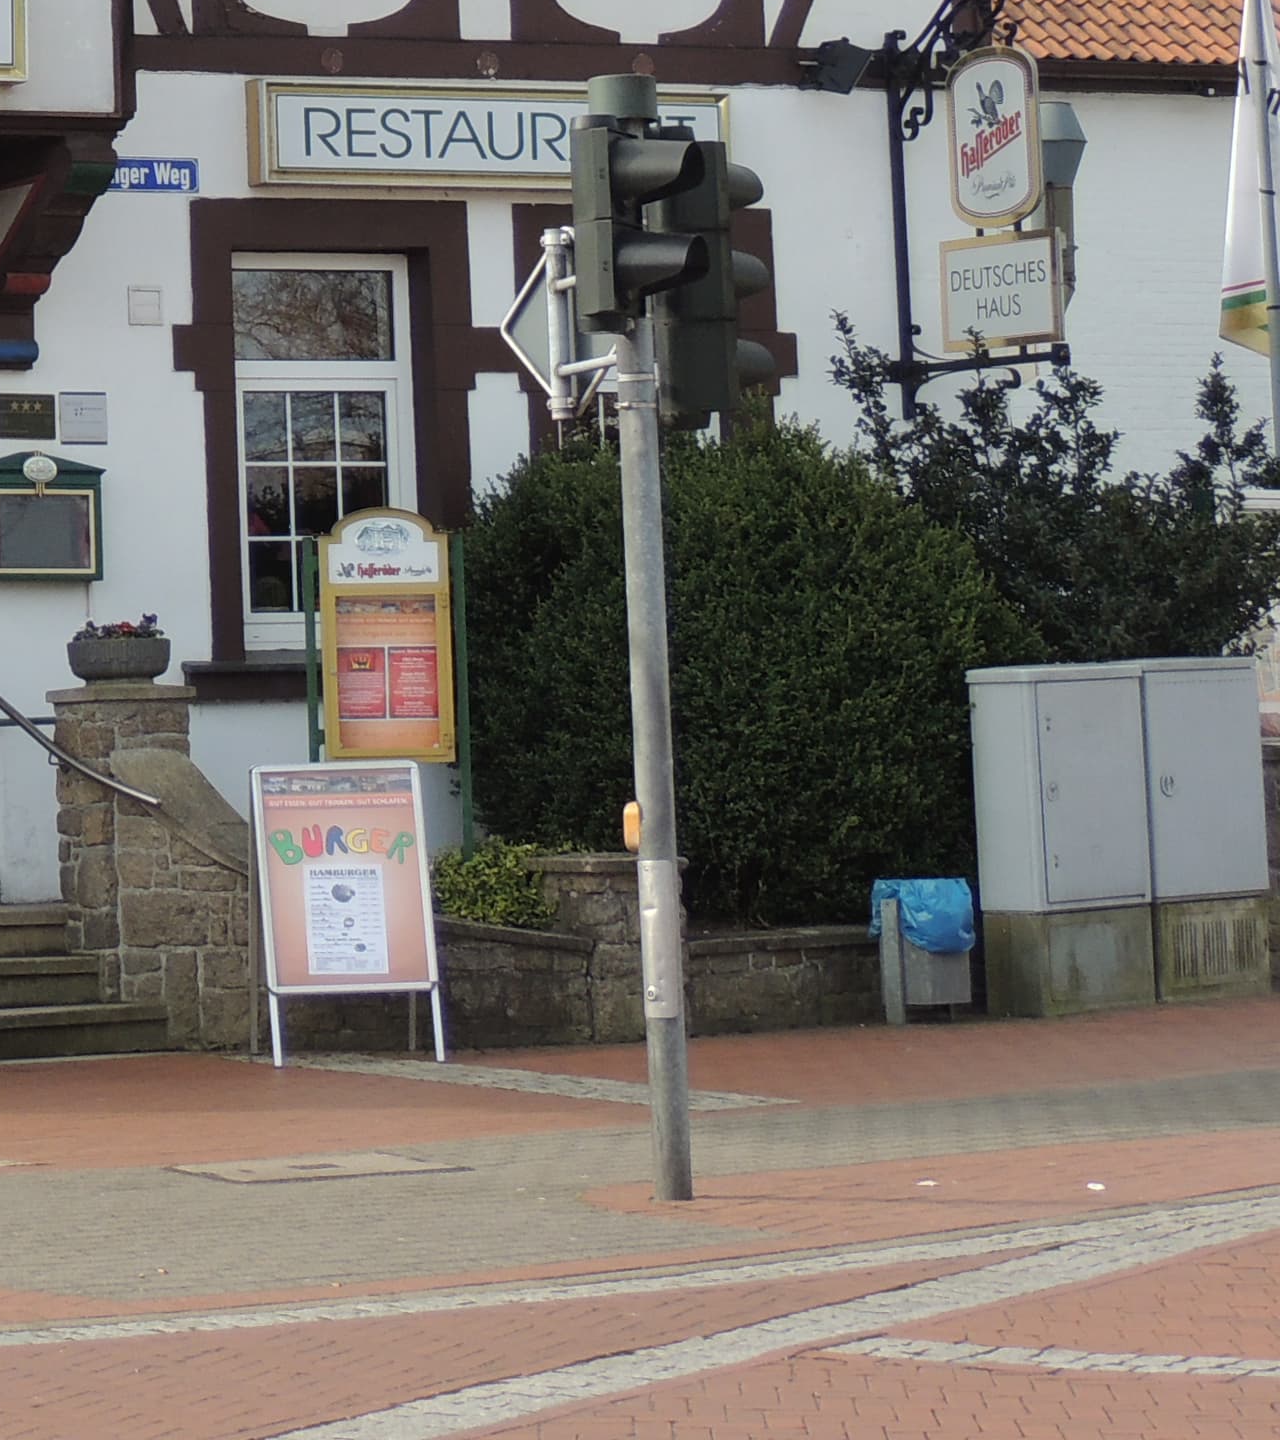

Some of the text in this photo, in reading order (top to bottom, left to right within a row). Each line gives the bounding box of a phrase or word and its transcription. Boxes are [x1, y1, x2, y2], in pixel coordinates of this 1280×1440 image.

[302, 105, 697, 164] RESTAURT
[153, 162, 190, 190] Weg
[950, 259, 1047, 293] DEUTSCHES
[976, 293, 1022, 320] HAUS
[269, 823, 415, 865] BURGER
[309, 868, 377, 877] HAMBURGER
